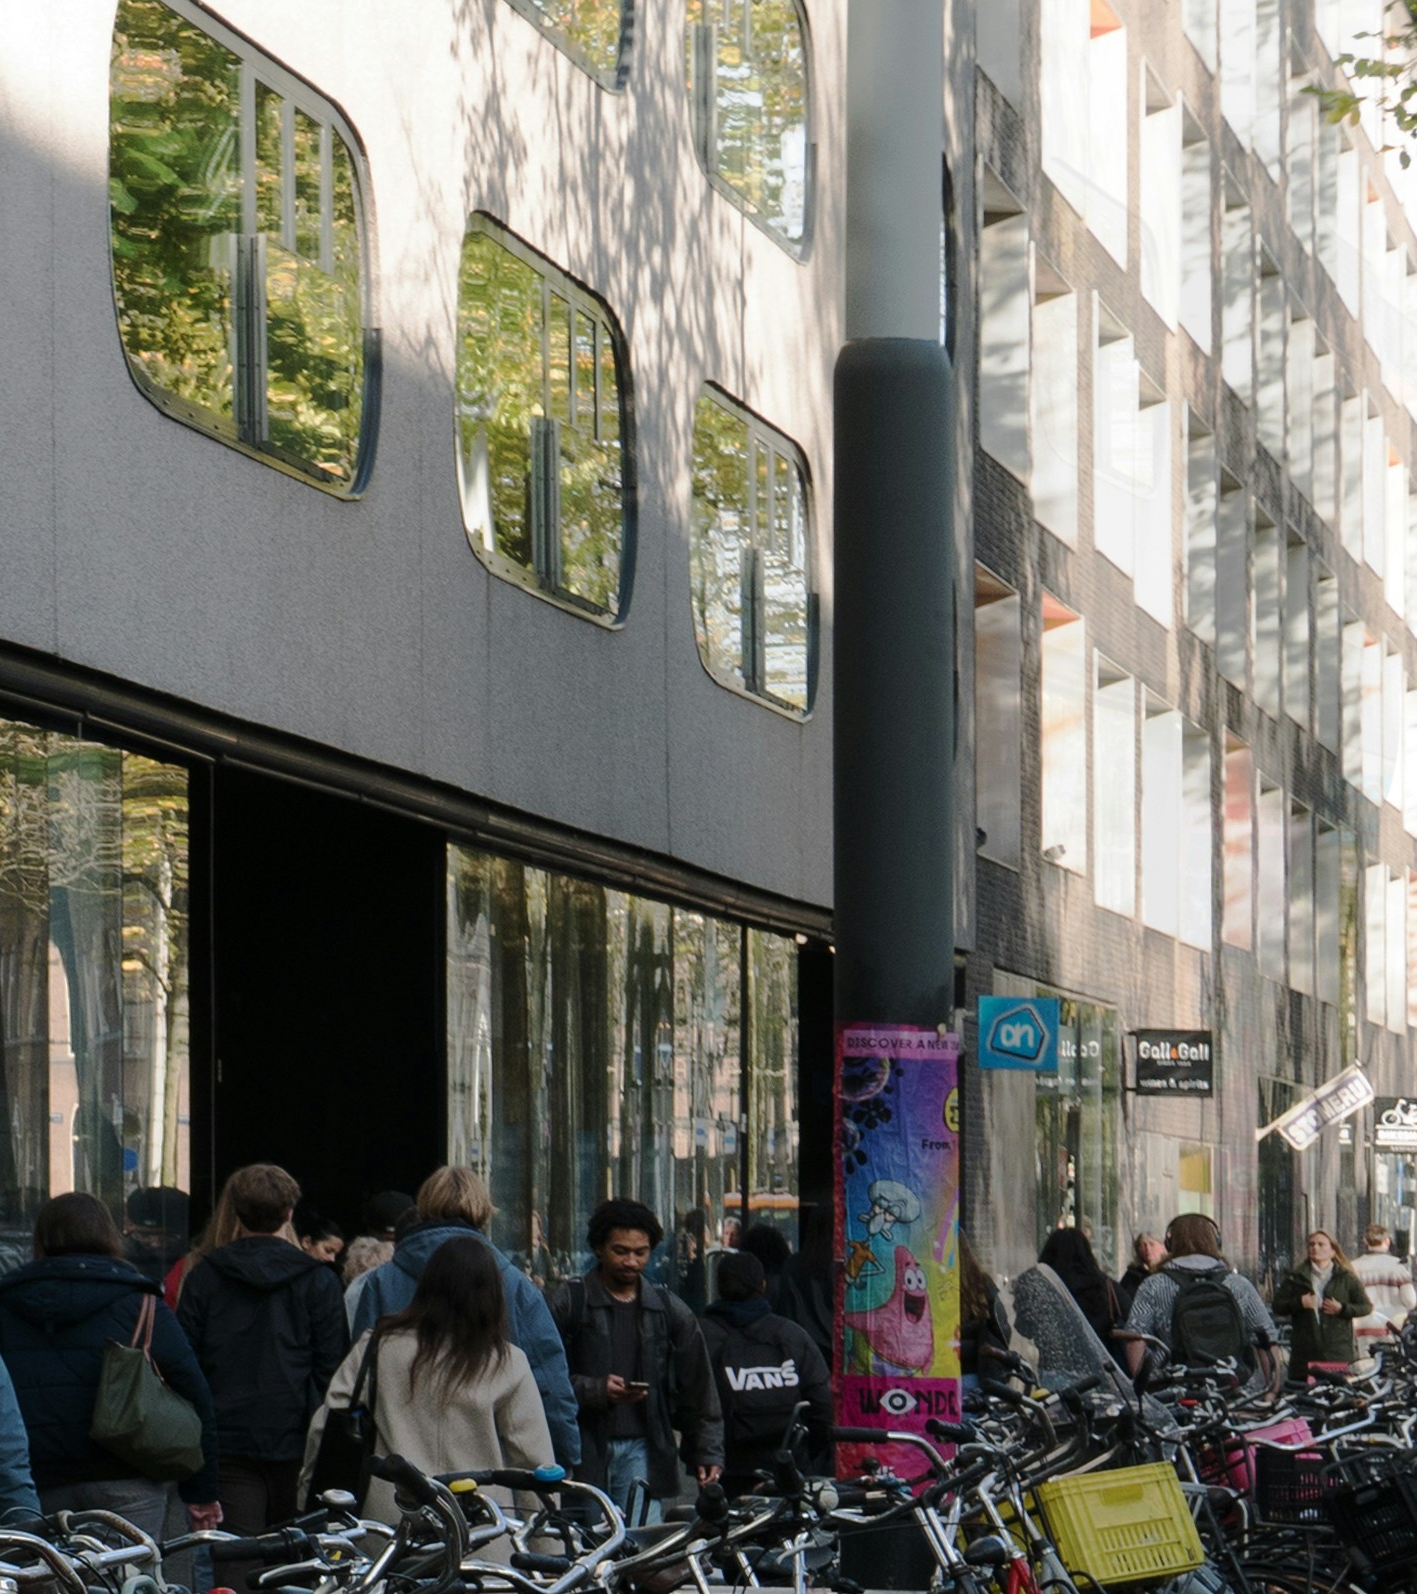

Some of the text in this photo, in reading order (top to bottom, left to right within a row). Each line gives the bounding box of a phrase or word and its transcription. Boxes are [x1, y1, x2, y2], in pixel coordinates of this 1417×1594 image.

[846, 1036, 912, 1049] DISCOVER
[917, 1038, 927, 1049] A
[724, 1358, 800, 1392] VANS
